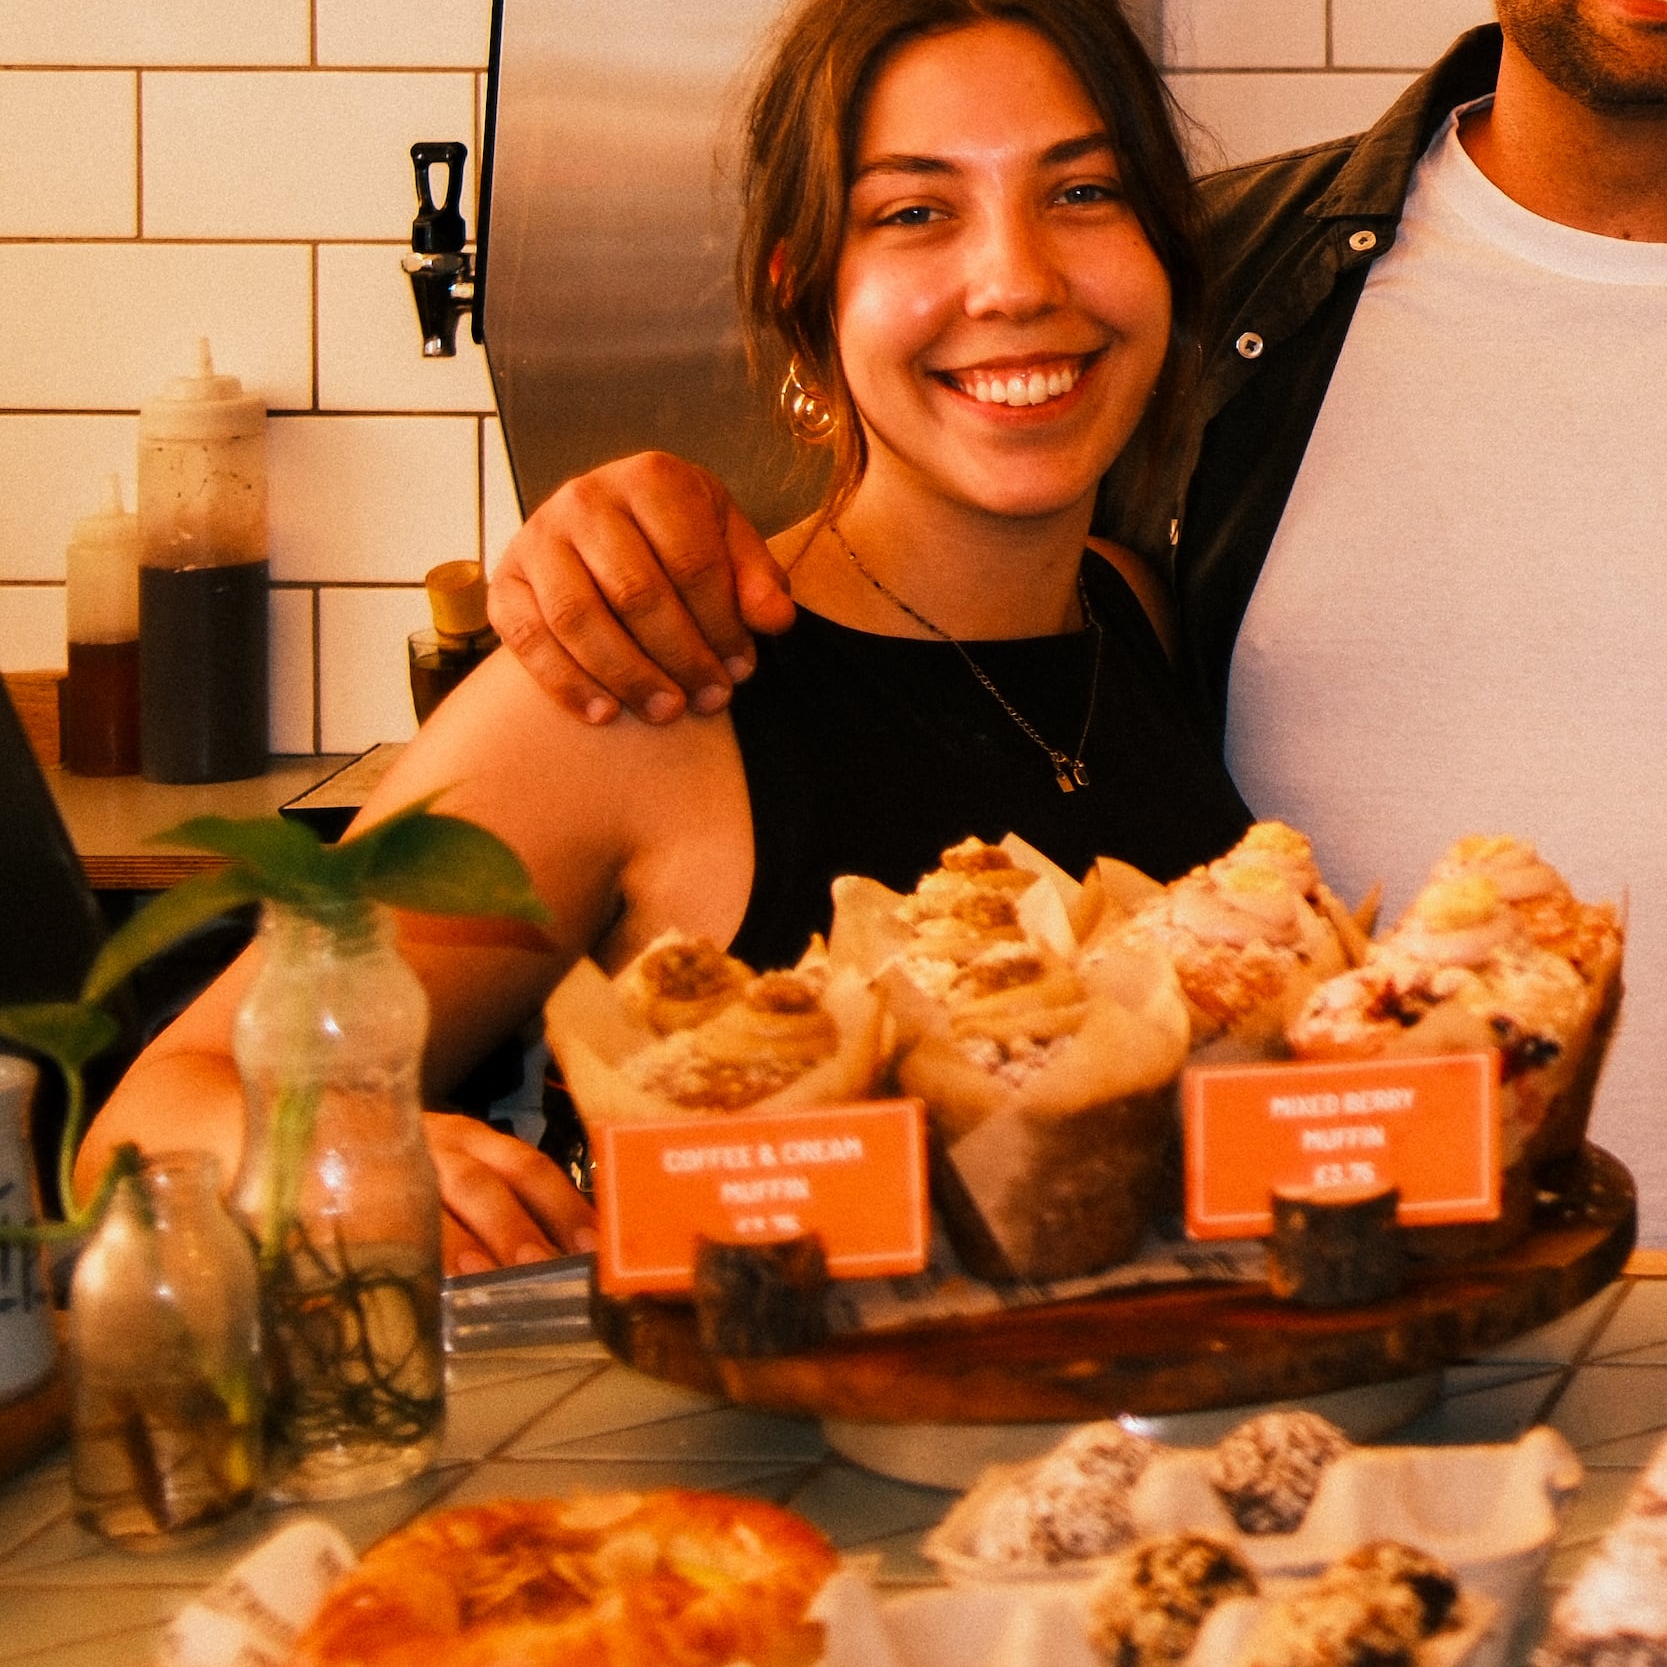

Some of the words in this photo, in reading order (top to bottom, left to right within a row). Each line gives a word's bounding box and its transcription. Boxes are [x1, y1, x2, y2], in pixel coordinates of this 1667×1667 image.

[1269, 1093, 1340, 1119] MIXED
[1343, 1087, 1415, 1115] BERRY
[1302, 1125, 1387, 1152] MUFFIN
[662, 1145, 752, 1174] COFFEE
[780, 1136, 865, 1165] CREAM
[719, 1176, 812, 1204] MUFFIN
